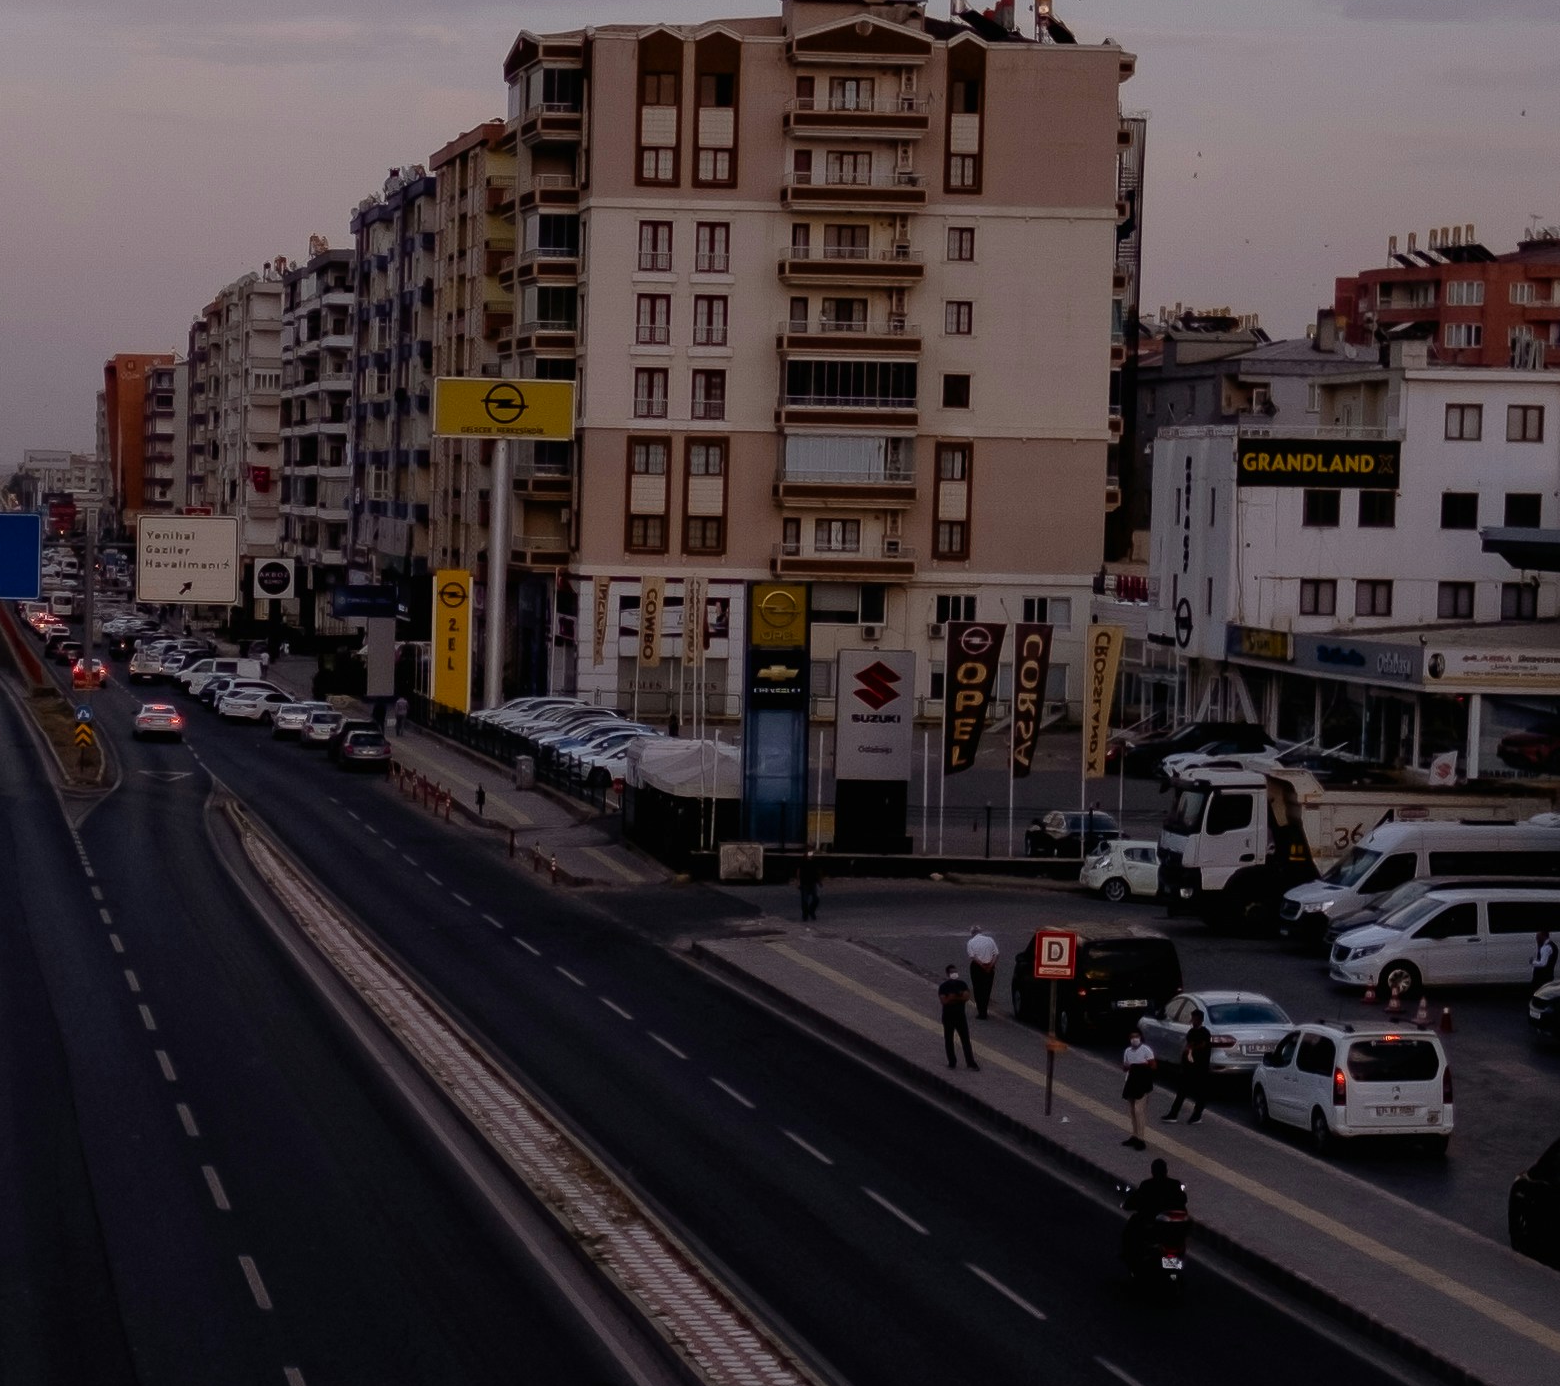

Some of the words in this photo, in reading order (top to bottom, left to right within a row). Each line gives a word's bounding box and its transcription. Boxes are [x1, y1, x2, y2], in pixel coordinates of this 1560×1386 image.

[1242, 452, 1375, 473] GRANDLAND
[1378, 454, 1395, 474] X
[146, 531, 195, 540] Yenihal
[145, 545, 190, 555] Gaziler
[852, 714, 901, 723] SUZUKI
[951, 662, 988, 768] OPEL
[1047, 941, 1064, 962] D
